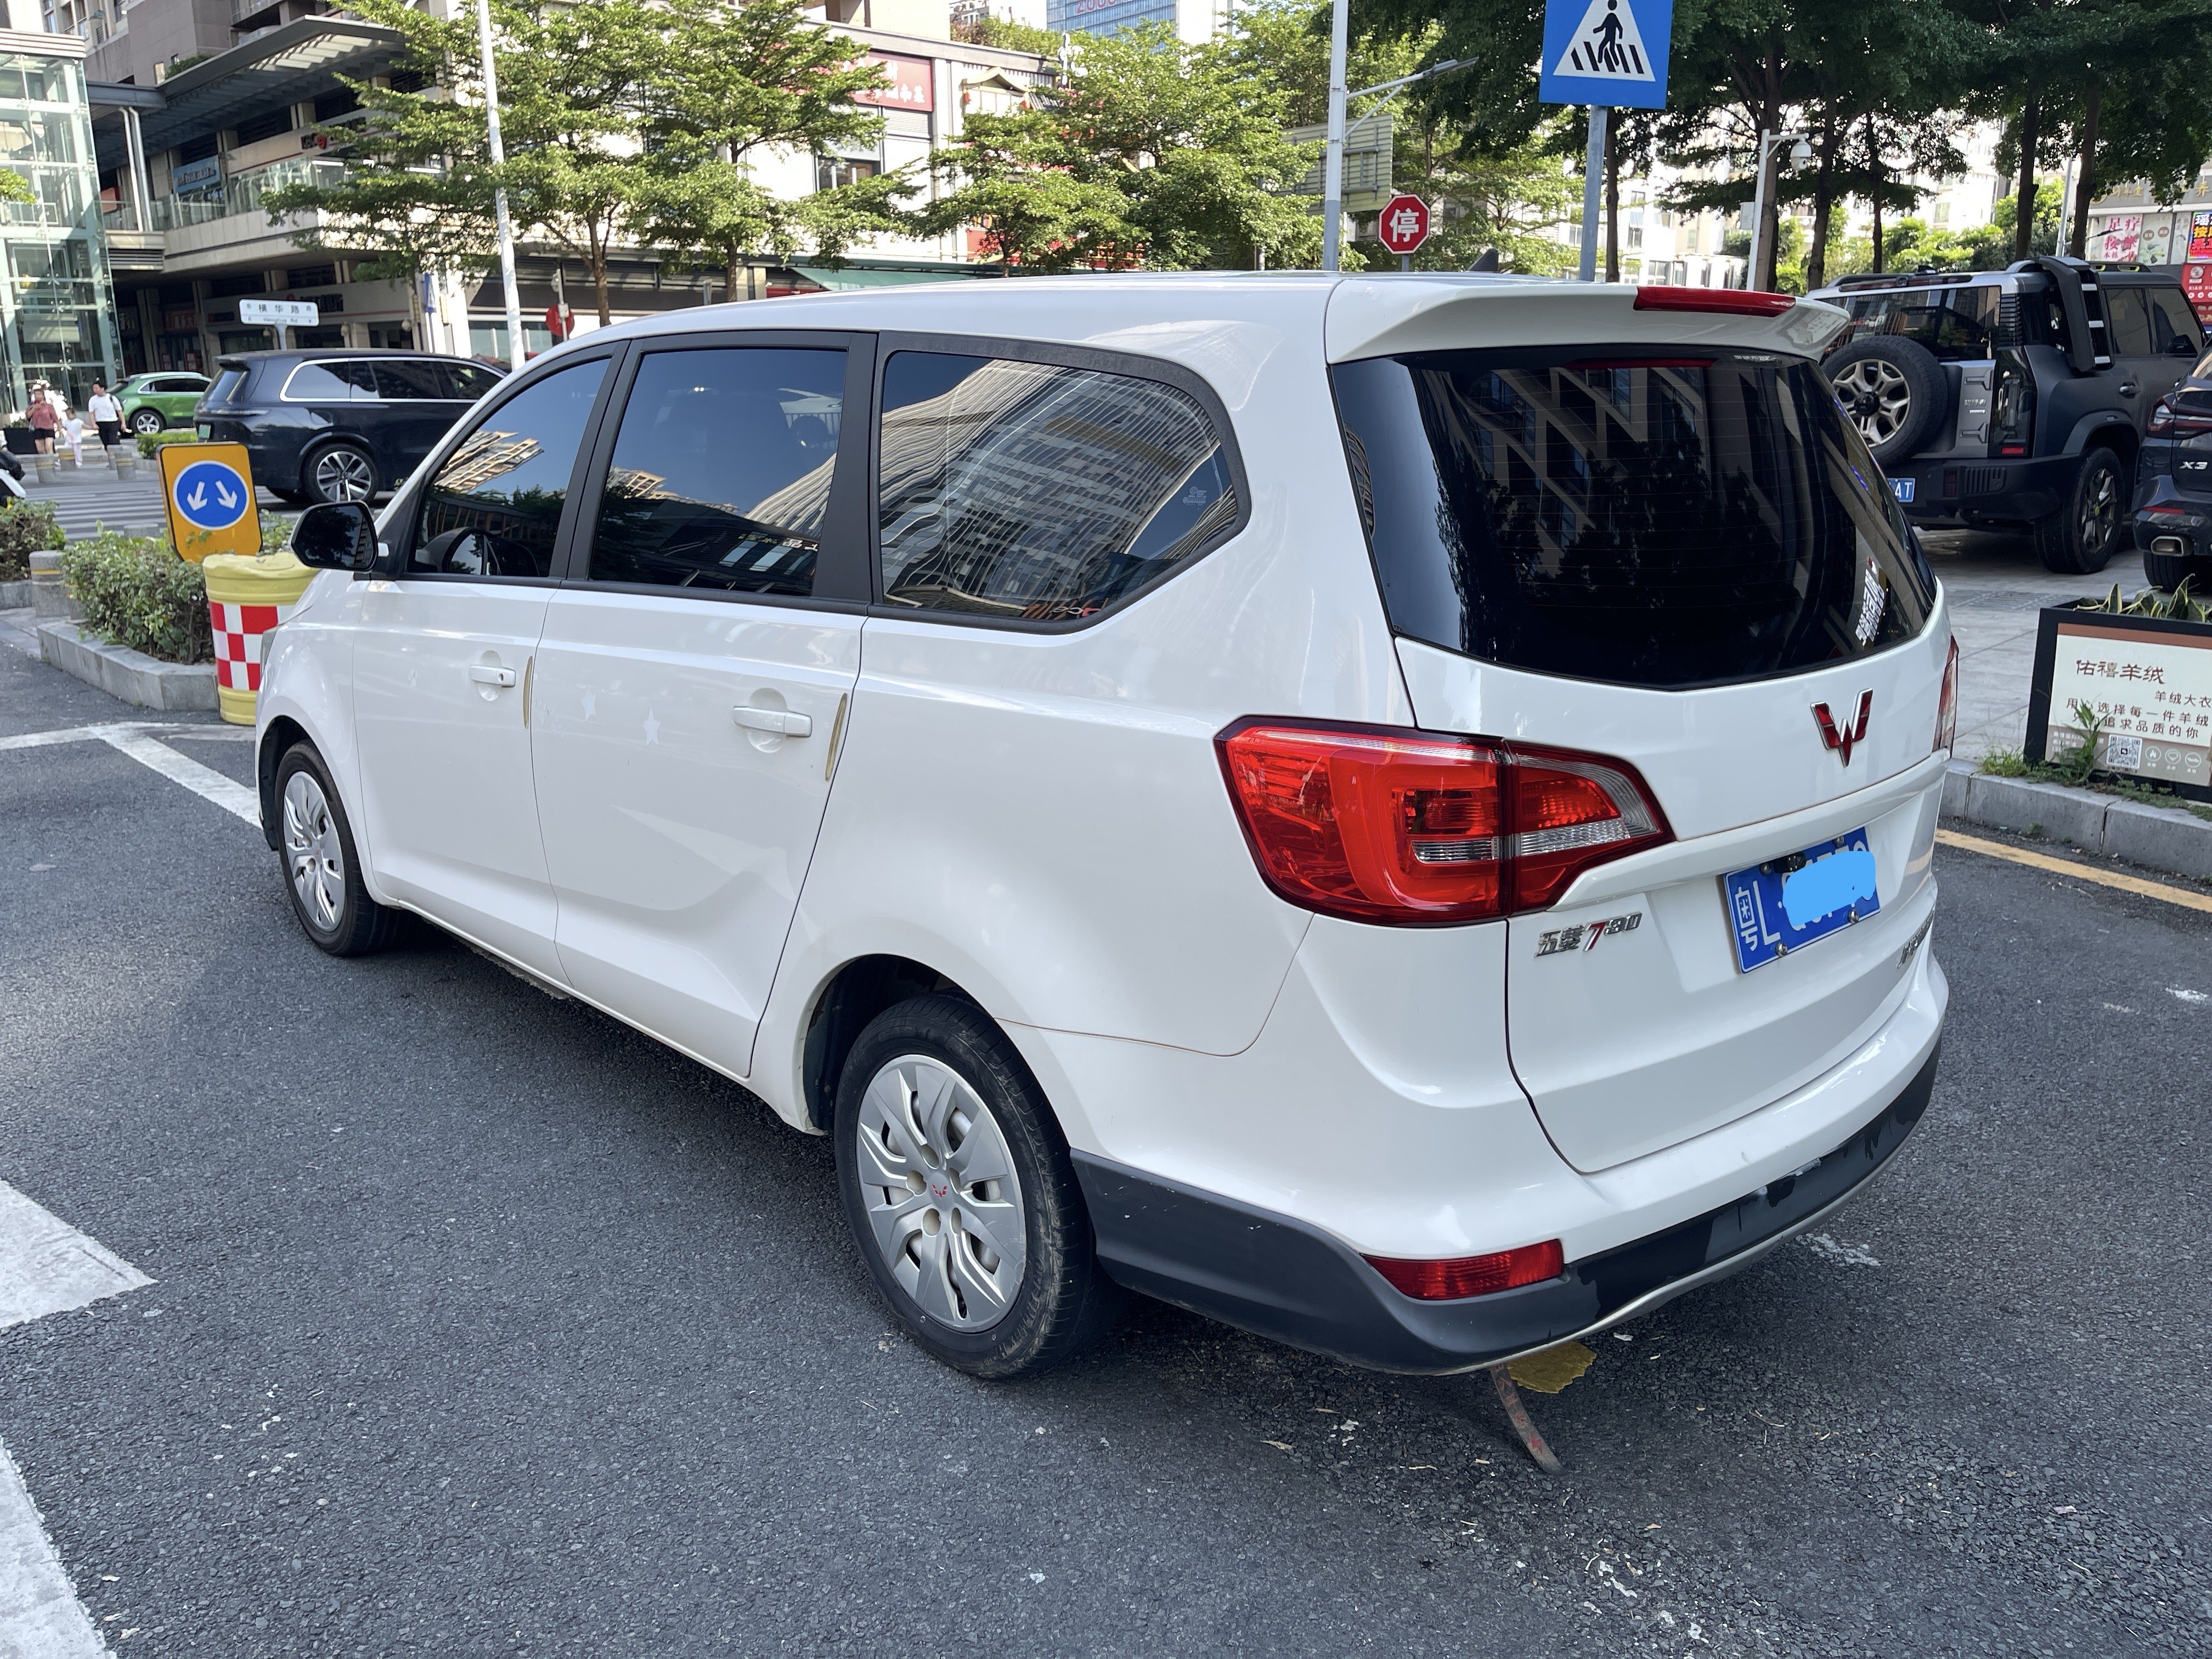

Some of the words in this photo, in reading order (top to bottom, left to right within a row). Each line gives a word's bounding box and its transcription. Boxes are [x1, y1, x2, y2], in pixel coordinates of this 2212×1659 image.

[1389, 207, 1420, 242] 停
[2179, 461, 2208, 470] X3
[1889, 481, 1913, 499] AT
[2076, 659, 2165, 685] 佑禧羊绒
[2154, 690, 2212, 709] 羊绒大衣
